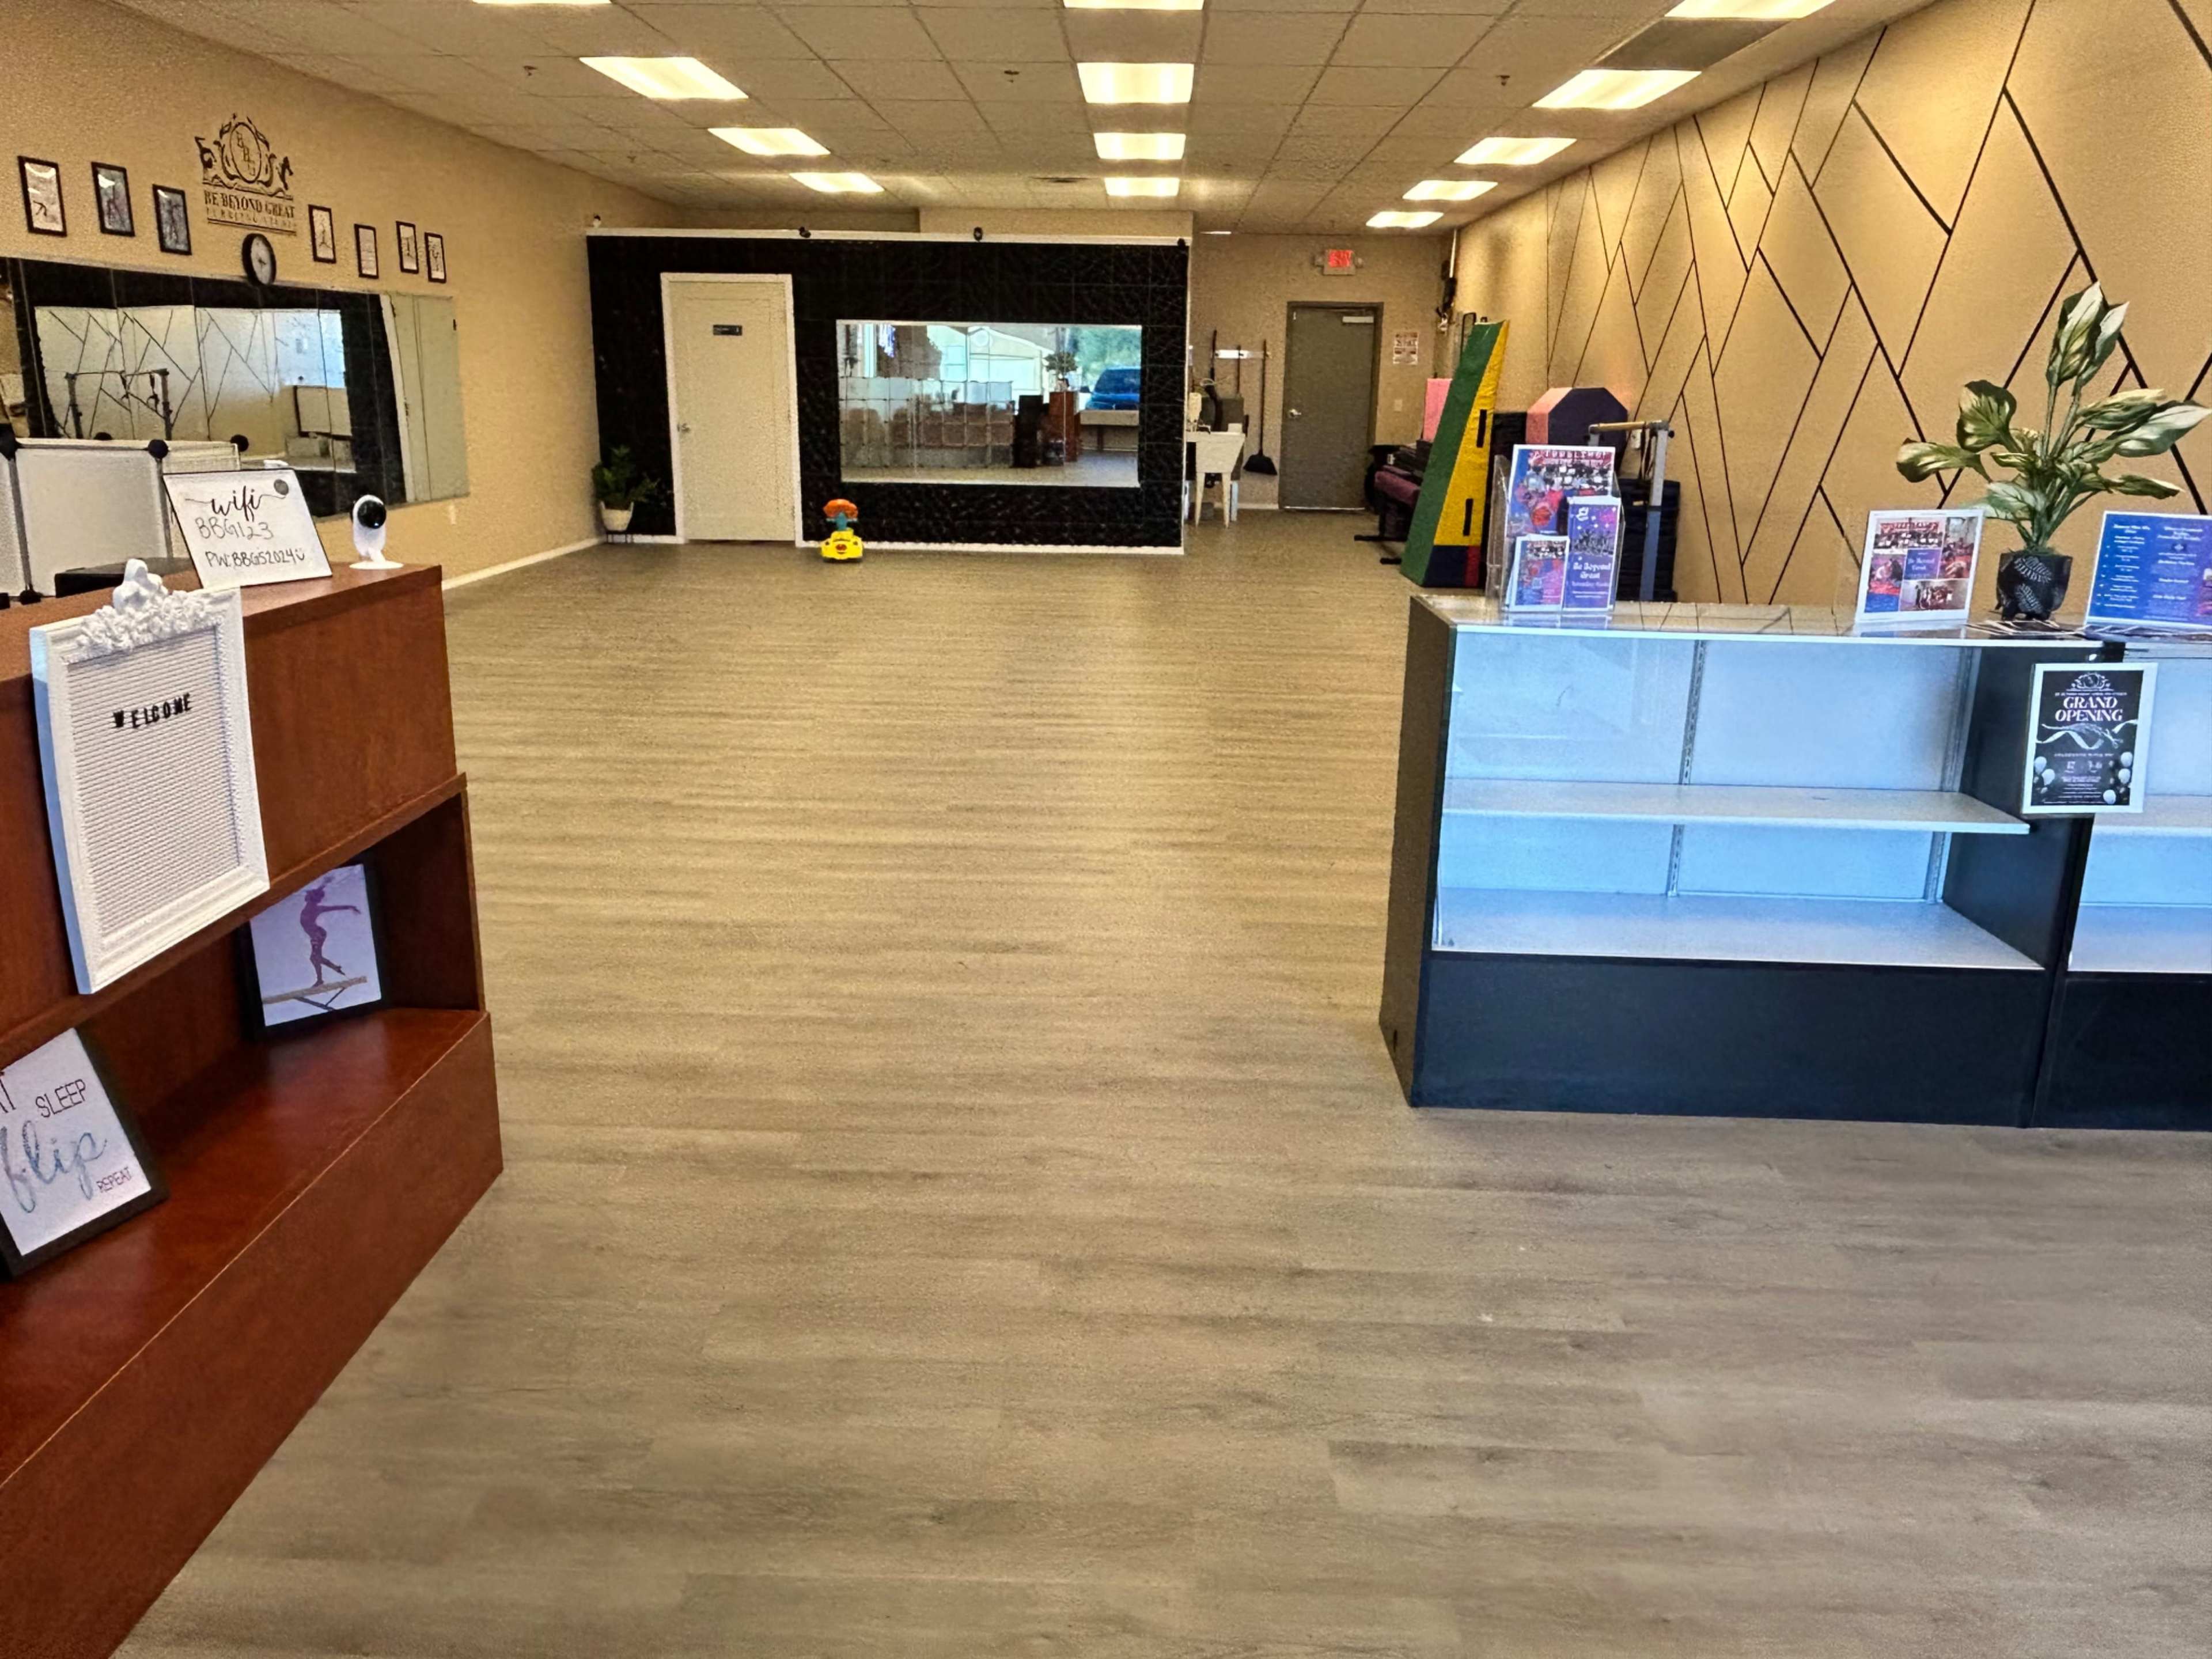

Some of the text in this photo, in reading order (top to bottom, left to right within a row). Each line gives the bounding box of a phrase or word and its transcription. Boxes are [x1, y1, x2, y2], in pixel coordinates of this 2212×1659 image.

[221, 192, 263, 213] BEYOND
[264, 202, 296, 218] GREAT
[195, 516, 275, 540] BBG123
[113, 692, 194, 729] WELCOME
[2055, 709, 2123, 722] OPENING
[2063, 696, 2118, 709] GRAND
[35, 1079, 86, 1118] SLEEP
[0, 1120, 108, 1213] flip
[96, 1166, 132, 1193] REPEAT
